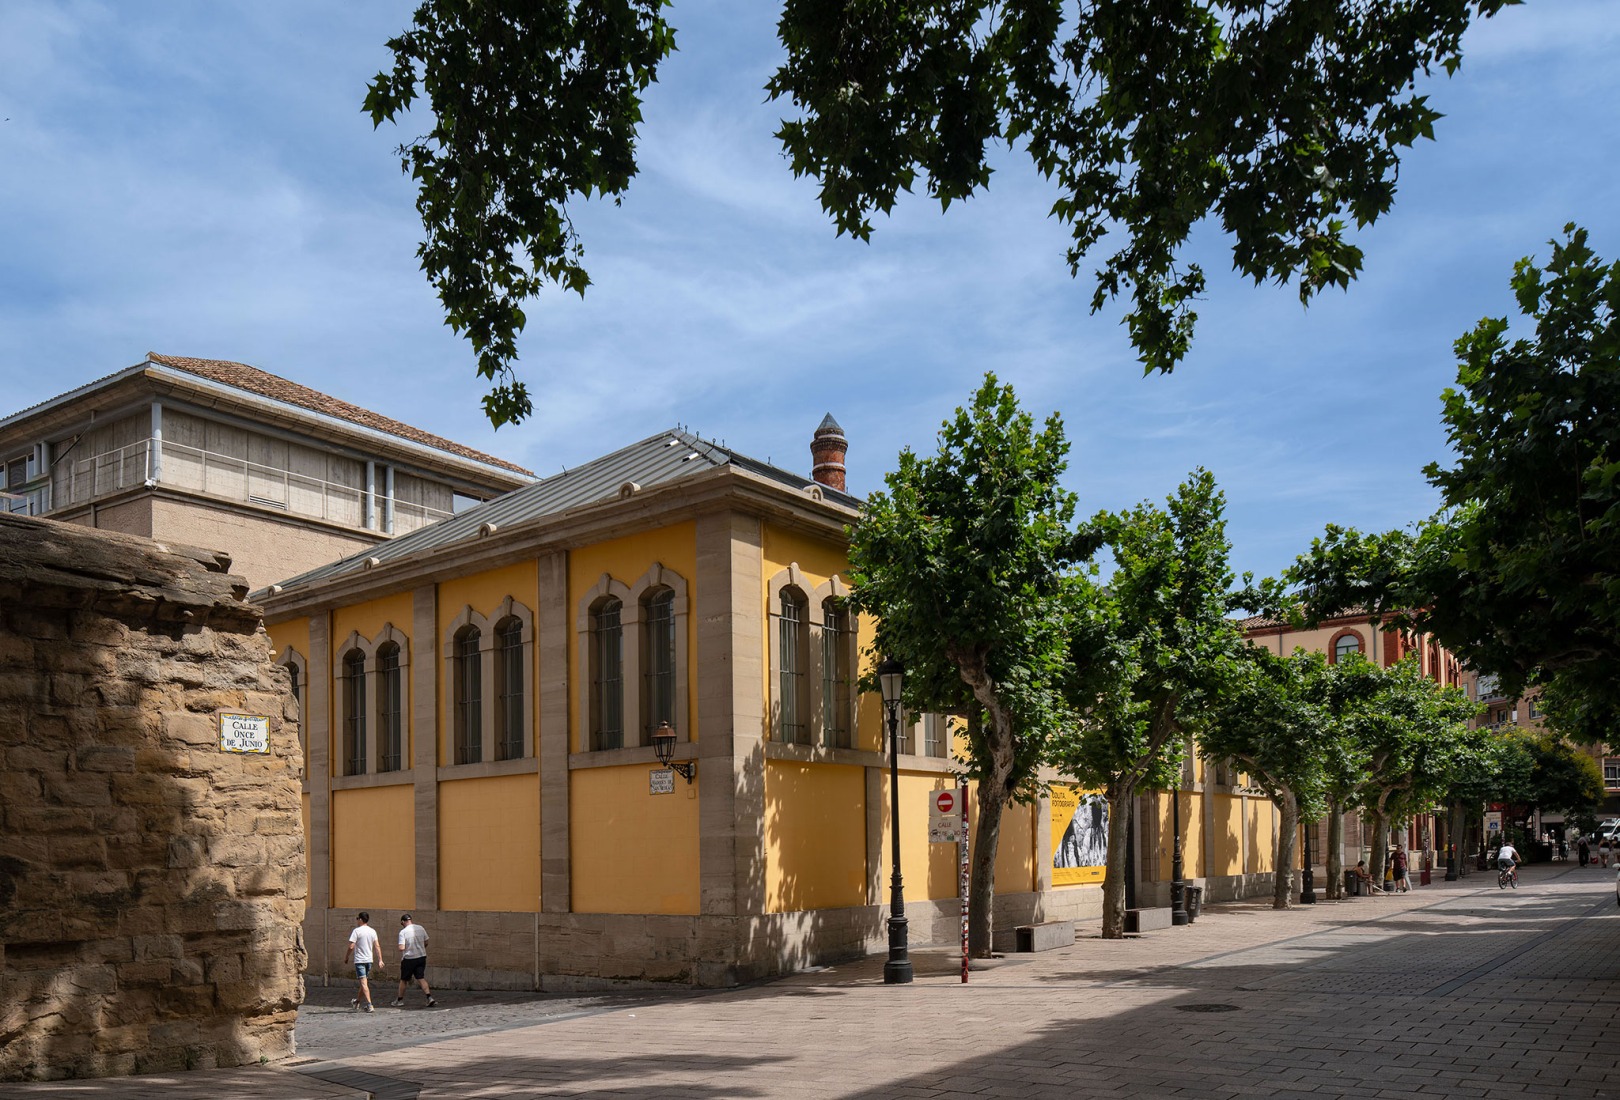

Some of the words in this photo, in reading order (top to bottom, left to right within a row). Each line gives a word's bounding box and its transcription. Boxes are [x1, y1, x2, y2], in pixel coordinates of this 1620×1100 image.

[232, 721, 258, 730] CALLE
[234, 730, 255, 738] ONCE
[239, 739, 263, 748] JUNIO
